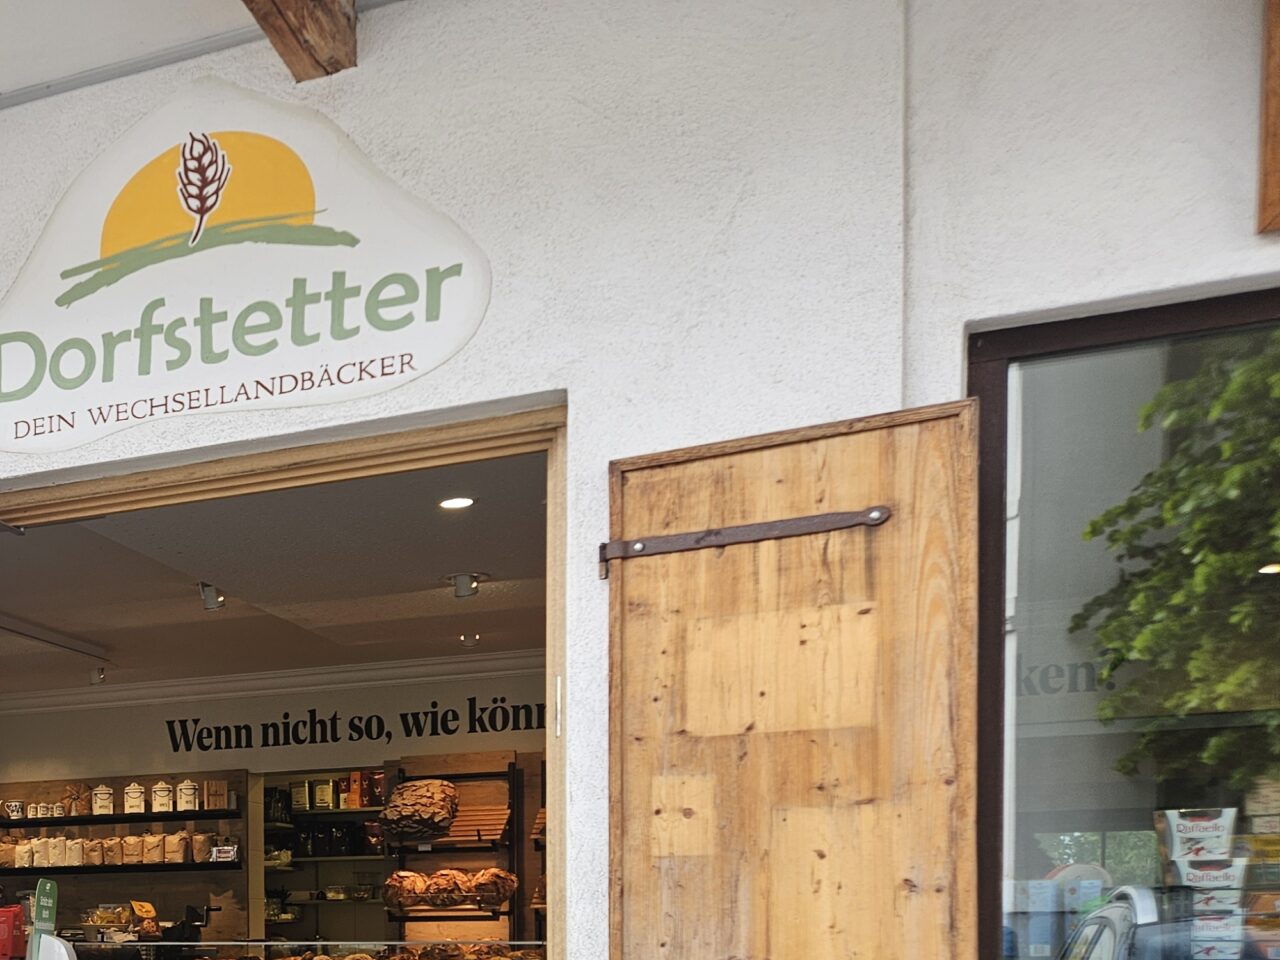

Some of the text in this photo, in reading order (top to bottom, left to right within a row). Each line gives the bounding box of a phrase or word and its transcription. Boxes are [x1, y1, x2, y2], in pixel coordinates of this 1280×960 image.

[13, 352, 418, 440] DEIN WECHSELLANDBÄCKER
[165, 717, 253, 753] Wenn
[260, 708, 342, 748] nicht
[348, 713, 392, 744] so,
[399, 700, 460, 738] wie
[1176, 823, 1225, 834] Raffaello
